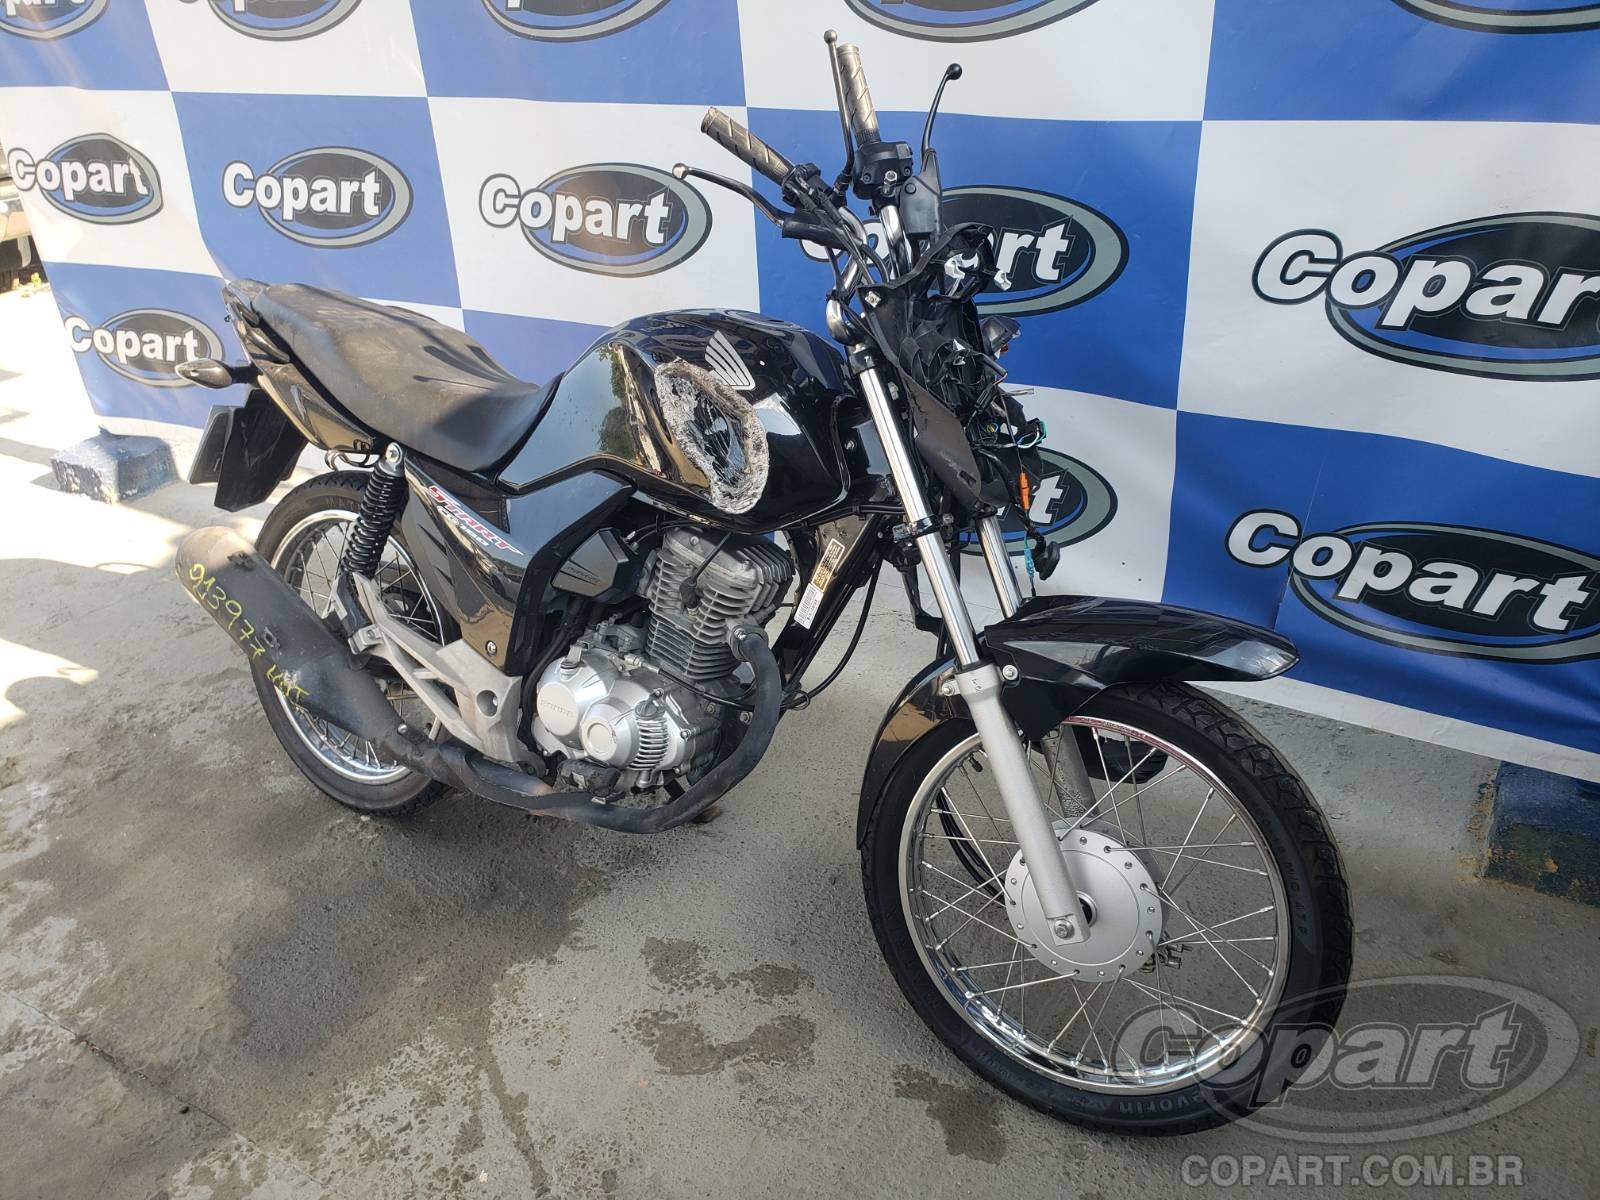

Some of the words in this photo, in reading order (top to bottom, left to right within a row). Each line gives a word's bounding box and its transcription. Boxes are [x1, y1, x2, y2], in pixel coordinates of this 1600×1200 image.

[8, 147, 149, 201] Copart
[222, 161, 381, 222] Copart
[479, 173, 671, 245] Copart
[1251, 228, 1600, 332] Copar
[64, 315, 200, 364] Copart
[1225, 508, 1592, 634] Copart
